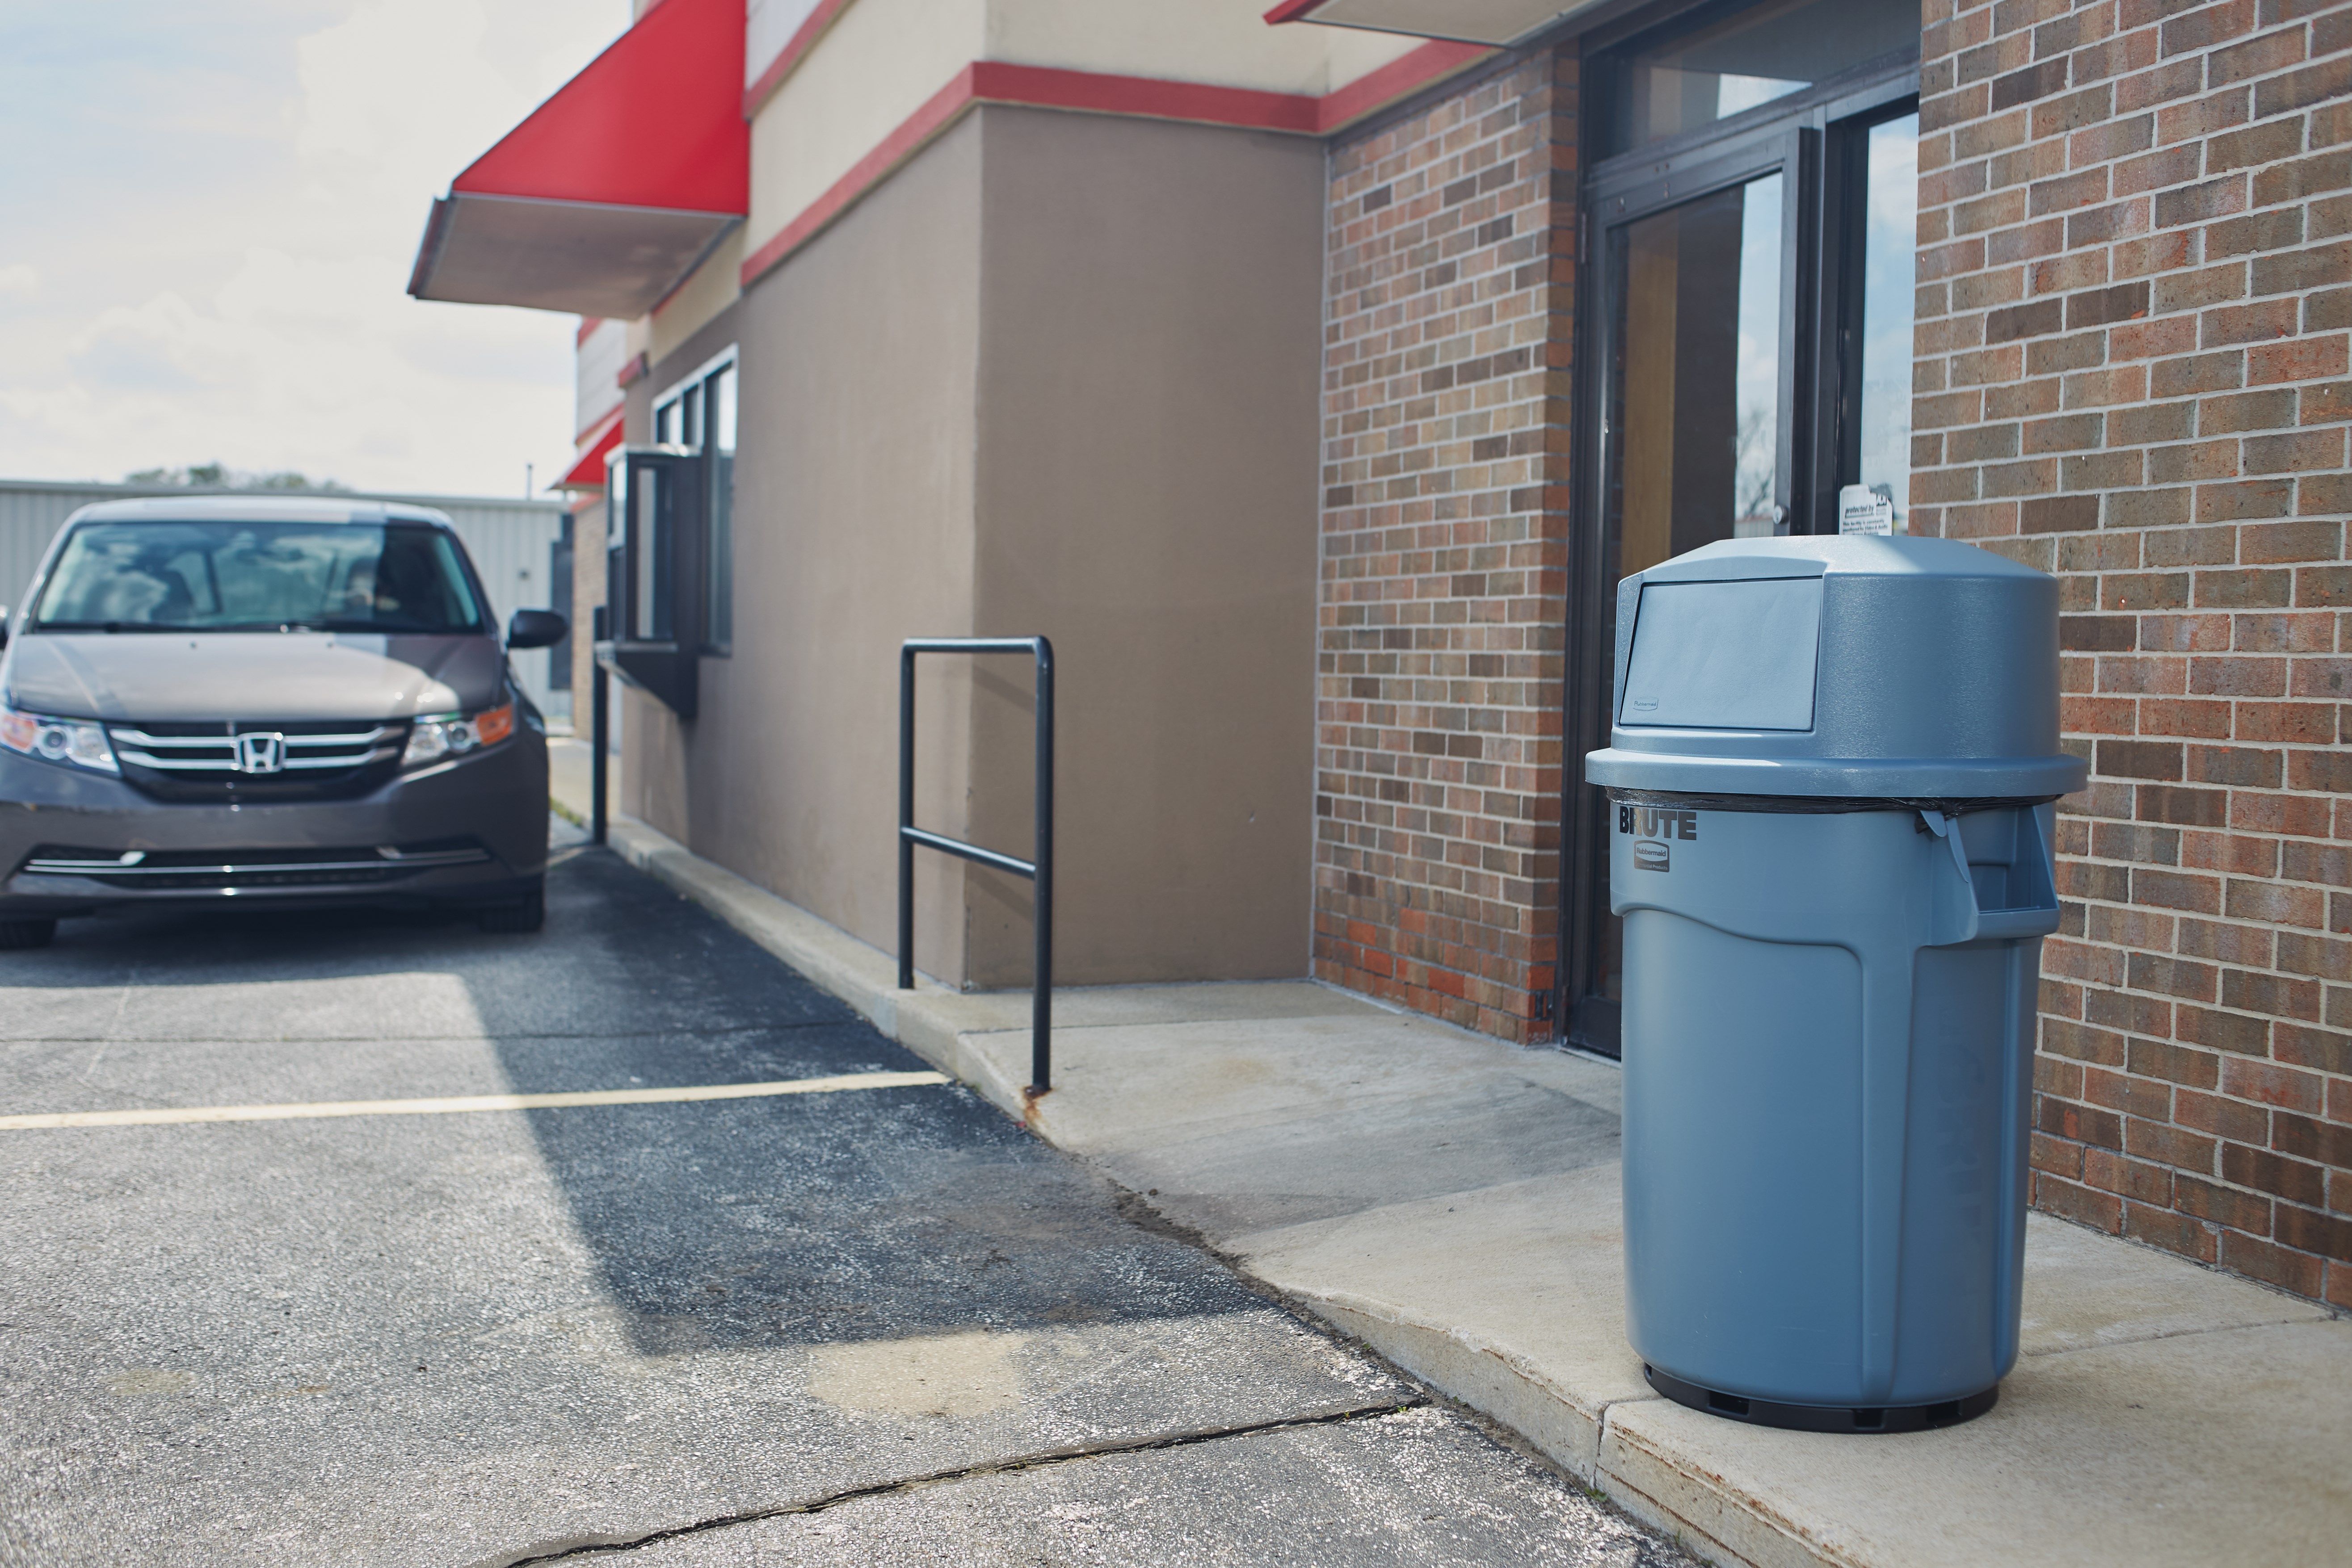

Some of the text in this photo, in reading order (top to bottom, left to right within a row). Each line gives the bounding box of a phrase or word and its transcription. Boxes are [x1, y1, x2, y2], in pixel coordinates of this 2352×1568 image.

[1845, 506, 1868, 518] protected
[1868, 504, 1873, 515] by
[1620, 806, 1697, 841] BRUTE
[1636, 847, 1666, 857] Rubbermaid
